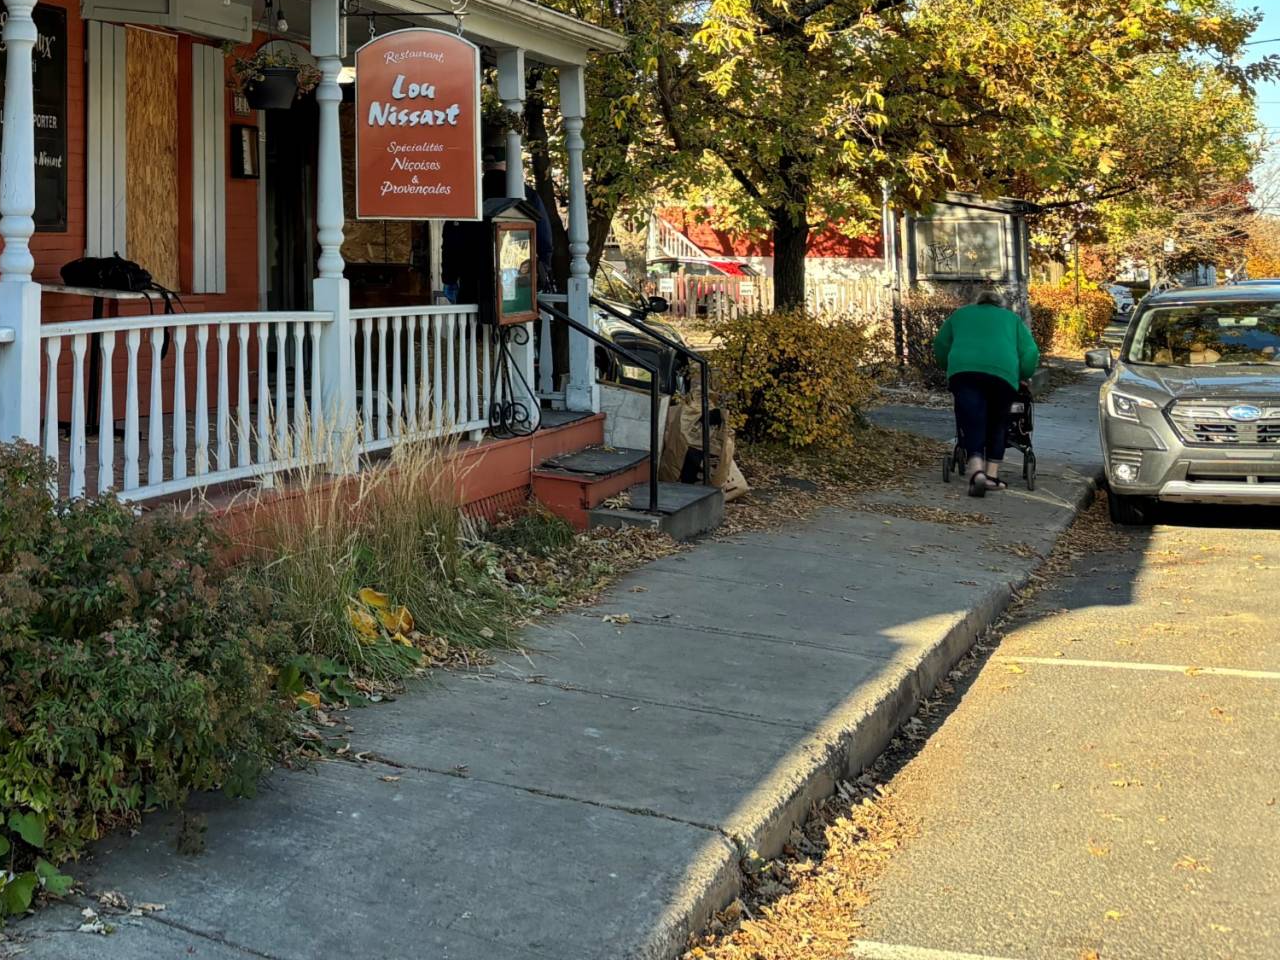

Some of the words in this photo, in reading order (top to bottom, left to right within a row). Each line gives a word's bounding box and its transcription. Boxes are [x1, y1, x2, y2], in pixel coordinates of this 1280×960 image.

[383, 50, 445, 64] Restaurant
[392, 74, 436, 100] Lou
[368, 101, 460, 127] Nissart
[390, 157, 441, 172] Niçoises
[411, 175, 420, 184] &
[380, 181, 452, 196] Provençales
